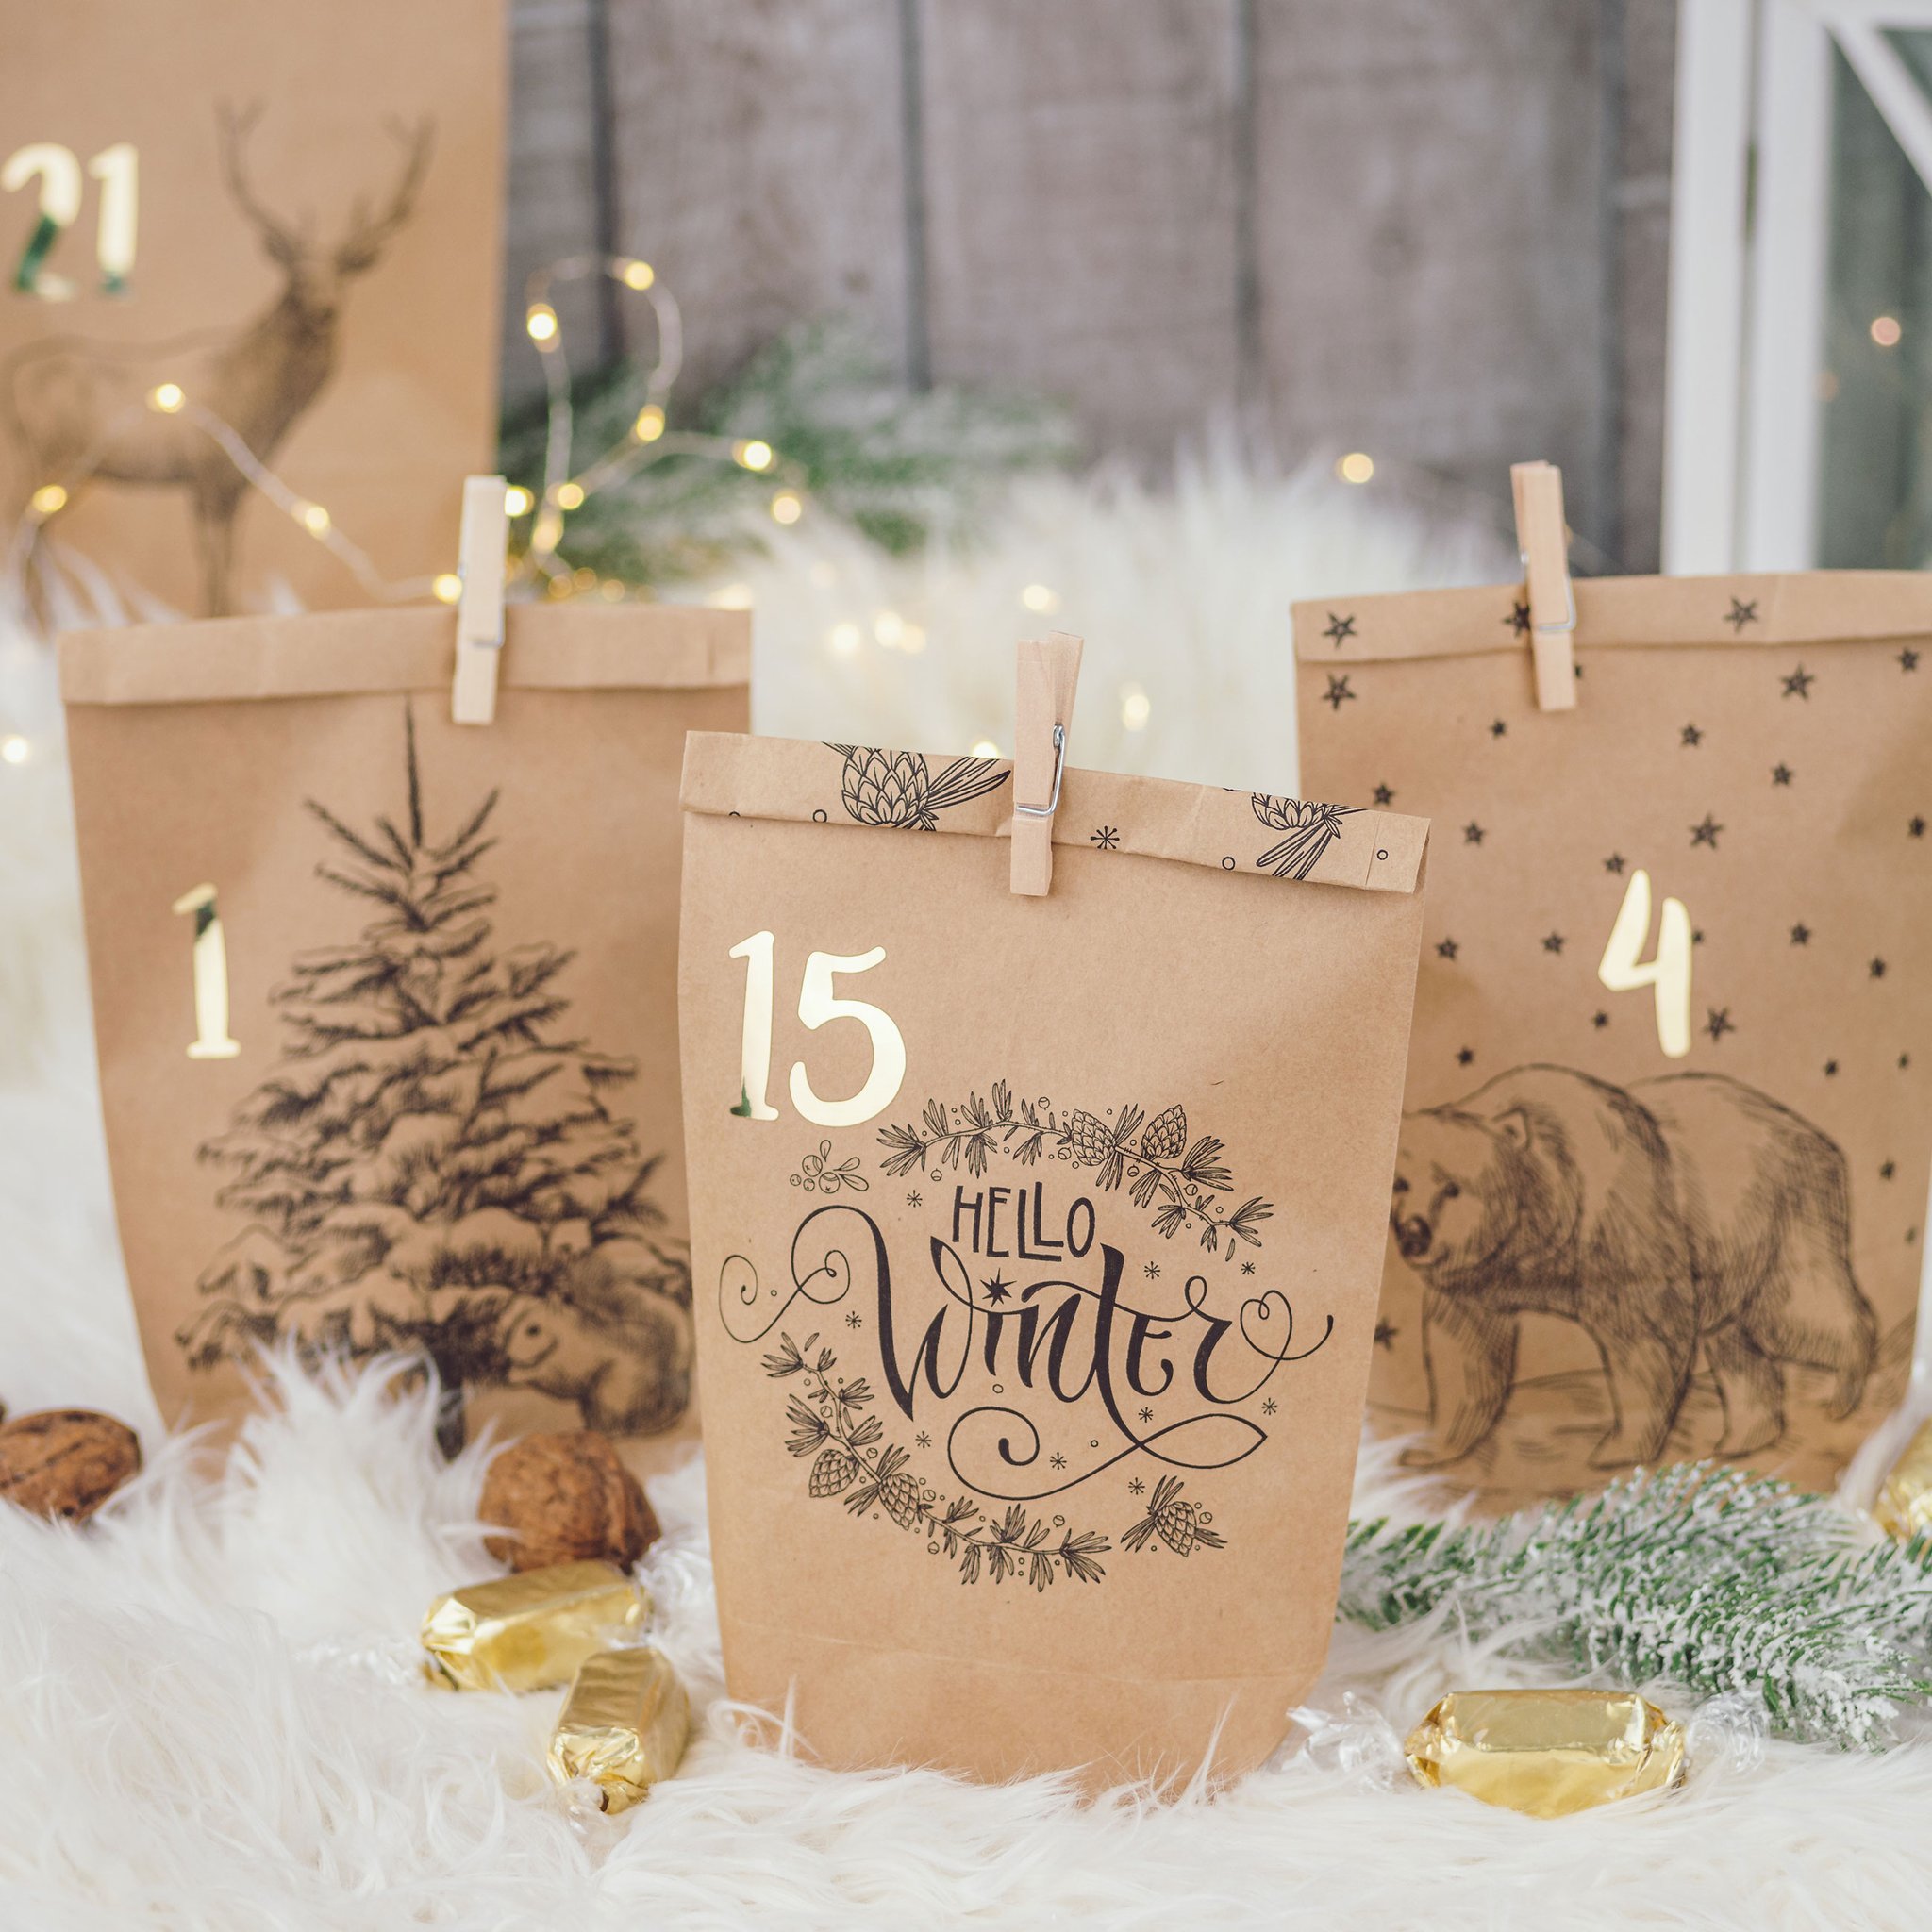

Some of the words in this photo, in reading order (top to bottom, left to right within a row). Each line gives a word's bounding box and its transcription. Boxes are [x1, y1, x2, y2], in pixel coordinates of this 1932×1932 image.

[1, 142, 140, 302] 21
[171, 882, 242, 1059] 1
[728, 930, 907, 1127] 15
[1598, 869, 1692, 1058] 4
[952, 1181, 1096, 1262] HELLO
[719, 1205, 1334, 1501] Winter
